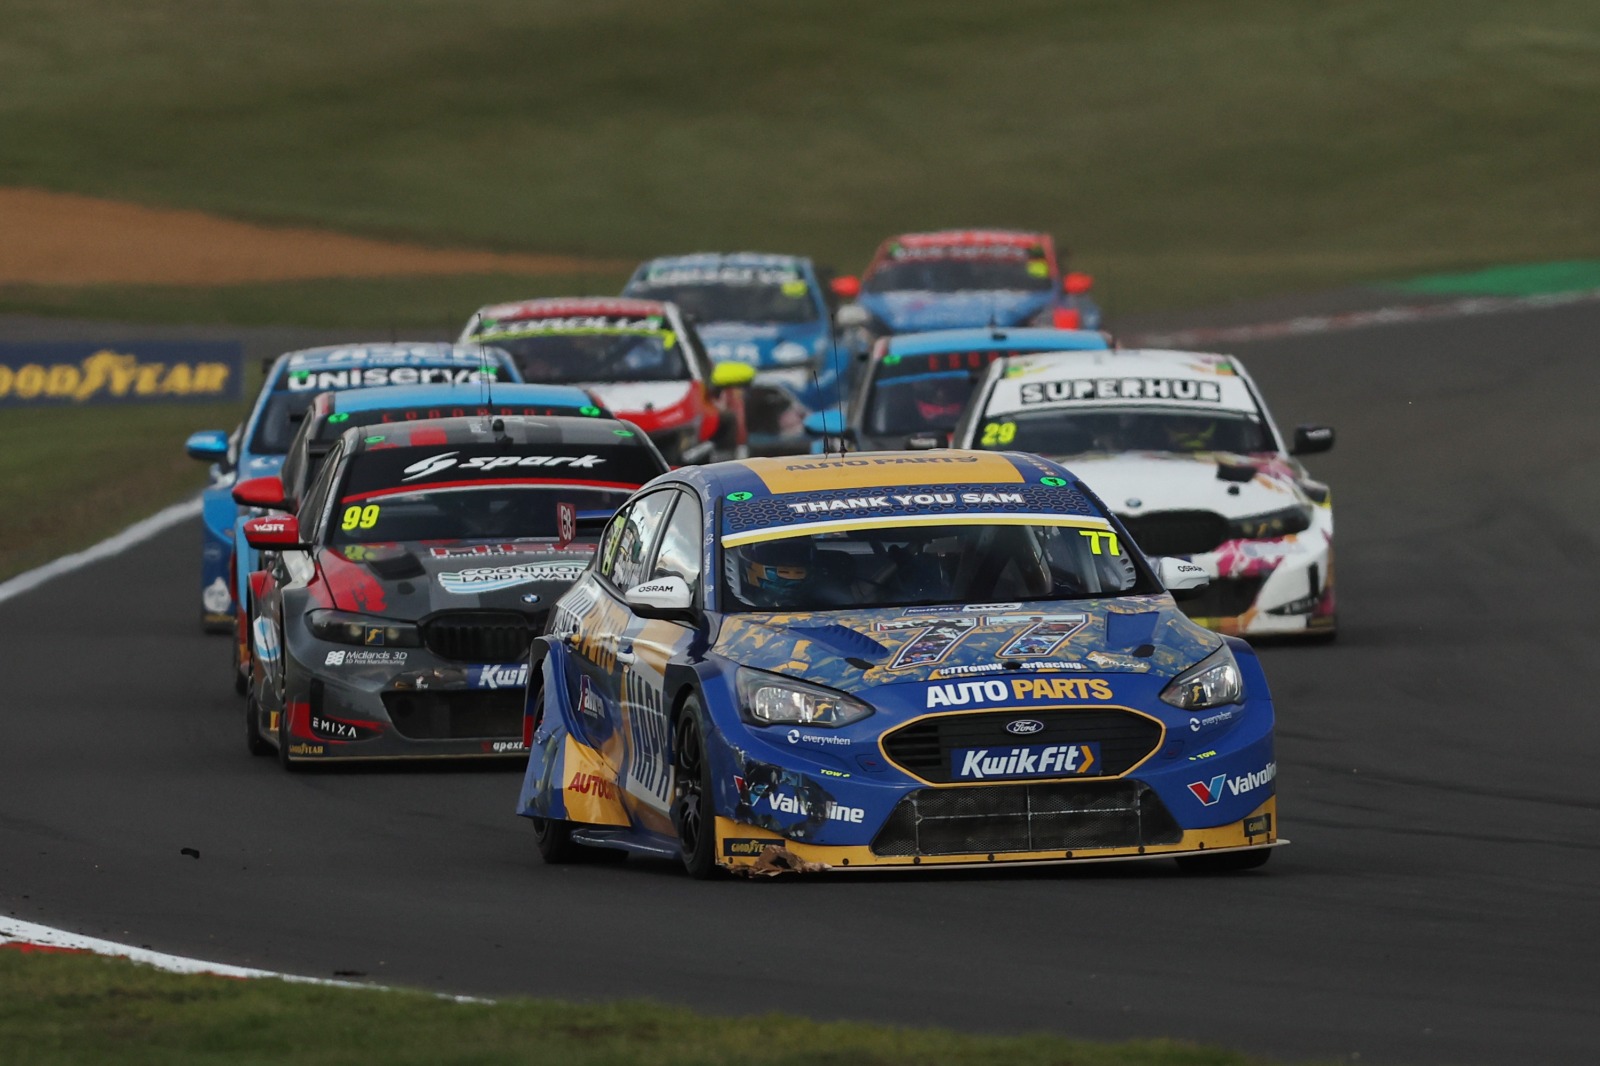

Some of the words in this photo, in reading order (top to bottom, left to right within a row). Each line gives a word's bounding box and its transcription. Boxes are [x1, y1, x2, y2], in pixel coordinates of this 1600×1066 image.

[1020, 379, 1221, 404] SUPERHUB
[981, 421, 1017, 446] 29
[459, 454, 606, 471] spark
[786, 459, 869, 471] AUTO
[872, 455, 978, 466] PARTS
[790, 496, 890, 513] THANK
[893, 493, 955, 505] YOU
[963, 492, 1025, 504] SAM
[341, 504, 380, 531] 99
[1080, 530, 1121, 556] 77
[462, 573, 513, 583] LAND
[530, 571, 582, 581] WATE
[638, 585, 674, 593] OSRAM
[346, 650, 390, 660] Midlands
[392, 651, 408, 660] 3D
[478, 663, 529, 690] Kwi
[926, 679, 1009, 709] AUTO
[1011, 678, 1114, 700] PARTS
[312, 716, 357, 738] EMIXA
[1013, 720, 1038, 733] Ford
[1201, 711, 1233, 727] everywhen
[493, 742, 529, 752] apexr
[802, 733, 851, 746] everywhen
[1197, 750, 1216, 759] TOW
[820, 768, 843, 778] TOW
[768, 791, 865, 824] Valvline
[731, 840, 766, 854] GOODYE
